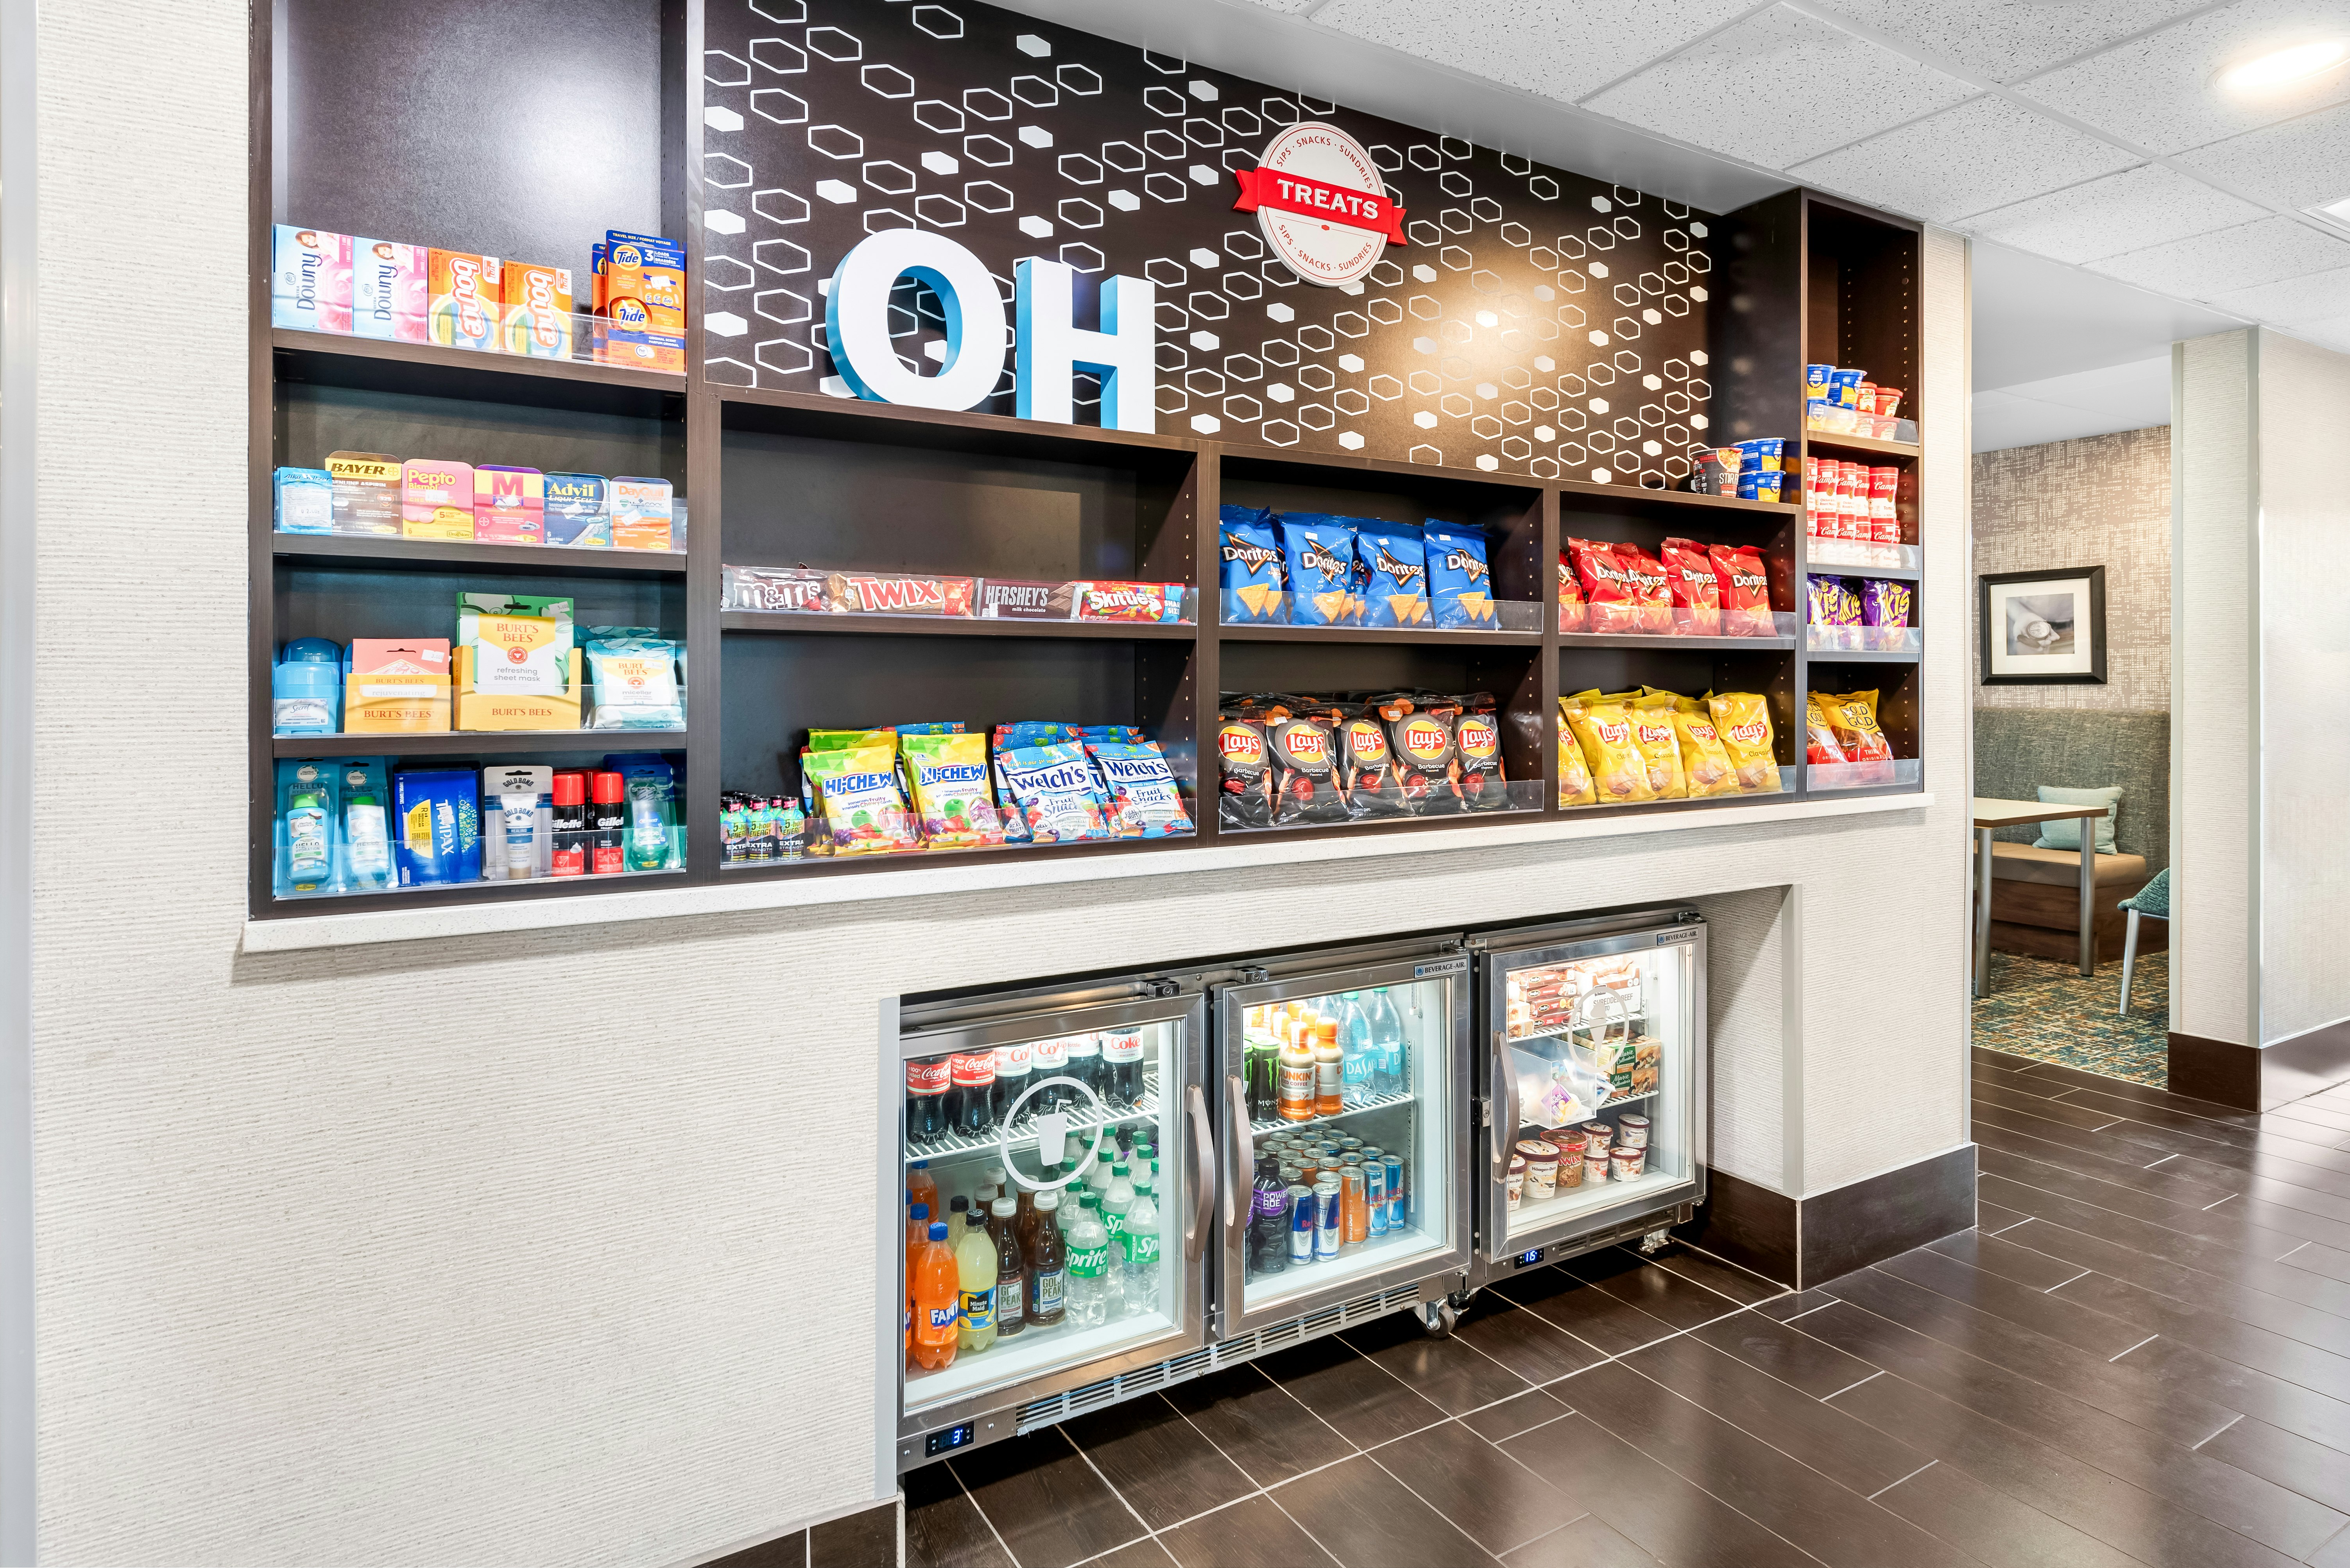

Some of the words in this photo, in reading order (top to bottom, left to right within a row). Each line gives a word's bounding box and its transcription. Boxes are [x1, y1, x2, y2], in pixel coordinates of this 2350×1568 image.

[1276, 147, 1291, 167] SIPS
[1296, 136, 1331, 147] SNACKS
[1339, 145, 1373, 189] SUNDRIES
[1277, 178, 1378, 220] TREATS
[644, 249, 654, 261] 3
[1279, 224, 1293, 245] SIPS
[1298, 250, 1331, 271] SNACKS
[1339, 242, 1371, 271] SUNDRIES
[617, 252, 639, 264] Tide
[297, 253, 322, 310] Downy
[374, 265, 398, 320] Downy
[452, 259, 485, 337] bounce
[528, 271, 558, 345] bounce
[619, 308, 645, 325] Tide
[825, 228, 1155, 434] OH
[331, 464, 385, 475] BAYER
[408, 469, 456, 485] Pepto
[547, 482, 594, 497] Advil
[619, 485, 664, 498] DayQuil
[1223, 547, 1278, 562] Doritos
[1303, 552, 1347, 575] Doritos
[1377, 557, 1424, 580] Doritos
[1447, 555, 1489, 575] Doritos
[1599, 566, 1628, 583] Doritos
[986, 585, 1049, 607] HERSHEY'S
[1089, 590, 1158, 611] Skittles
[497, 623, 538, 633] BURT'S
[503, 633, 532, 643] BEES
[497, 667, 537, 676] refreshing
[372, 689, 425, 697] rejuvenating
[290, 704, 312, 713] Secret
[1408, 729, 1444, 751] Lay's
[1463, 729, 1494, 748] Lay's
[1601, 722, 1628, 744] Lay's
[1641, 725, 1670, 742] Lay's
[1689, 724, 1715, 741] Lay's
[1732, 722, 1766, 744] Lay's
[1224, 734, 1259, 754] Lay's
[1290, 734, 1324, 754] Lay's
[1352, 731, 1383, 752] Lay's
[1102, 761, 1168, 777] Welch's
[1234, 767, 1259, 776] Barbecue
[1364, 763, 1390, 771] Barbecue
[1473, 760, 1498, 769] Barbecue
[503, 778, 518, 787] GOLD
[518, 778, 534, 787] BOND
[825, 772, 891, 796] HI-CHEW
[1010, 766, 1086, 790] Welch's
[1132, 793, 1171, 805] Snacks
[1136, 788, 1162, 797] Fruit
[504, 808, 518, 818] GOLD
[519, 808, 534, 818] BOND
[750, 828, 771, 837] ENERGY
[1666, 931, 1696, 941] BEVERAGE-AIR
[1425, 962, 1464, 973] BEVERAGE-AIR
[1111, 1037, 1140, 1049] Coke
[1612, 1074, 1630, 1083] Marie
[1066, 1246, 1107, 1268] Sprite
[1001, 1293, 1020, 1305] PEAK
[1042, 1286, 1061, 1297] PEAK
